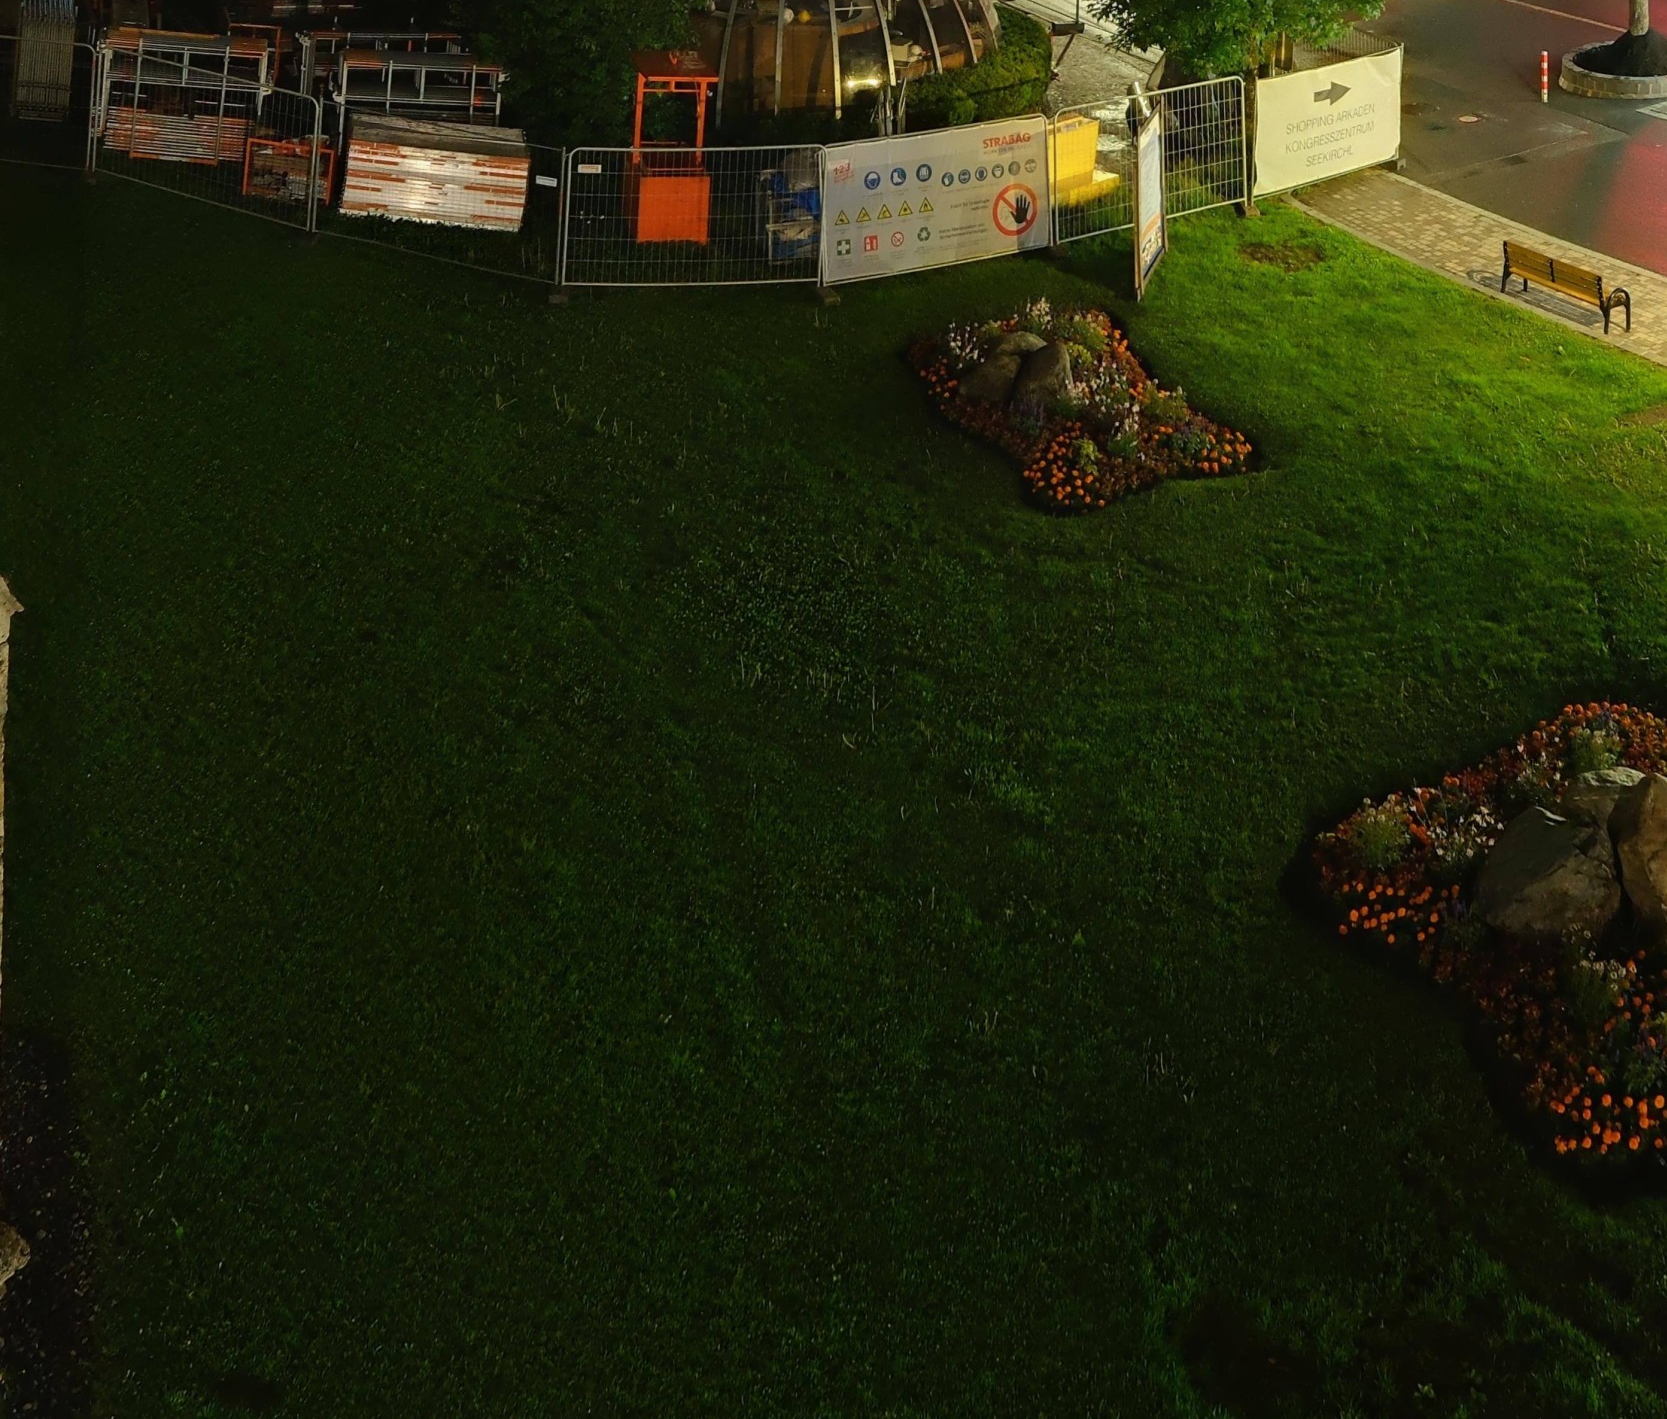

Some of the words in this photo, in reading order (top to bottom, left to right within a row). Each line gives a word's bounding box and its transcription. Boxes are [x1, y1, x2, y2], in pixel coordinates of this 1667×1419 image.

[1286, 114, 1335, 135] SHOPPING
[1336, 102, 1376, 122] ARKADEN
[983, 132, 1032, 149] STRABAG
[1285, 120, 1376, 154] KONGRESSZENTRUM
[1306, 145, 1354, 168] SEEKIRCHL
